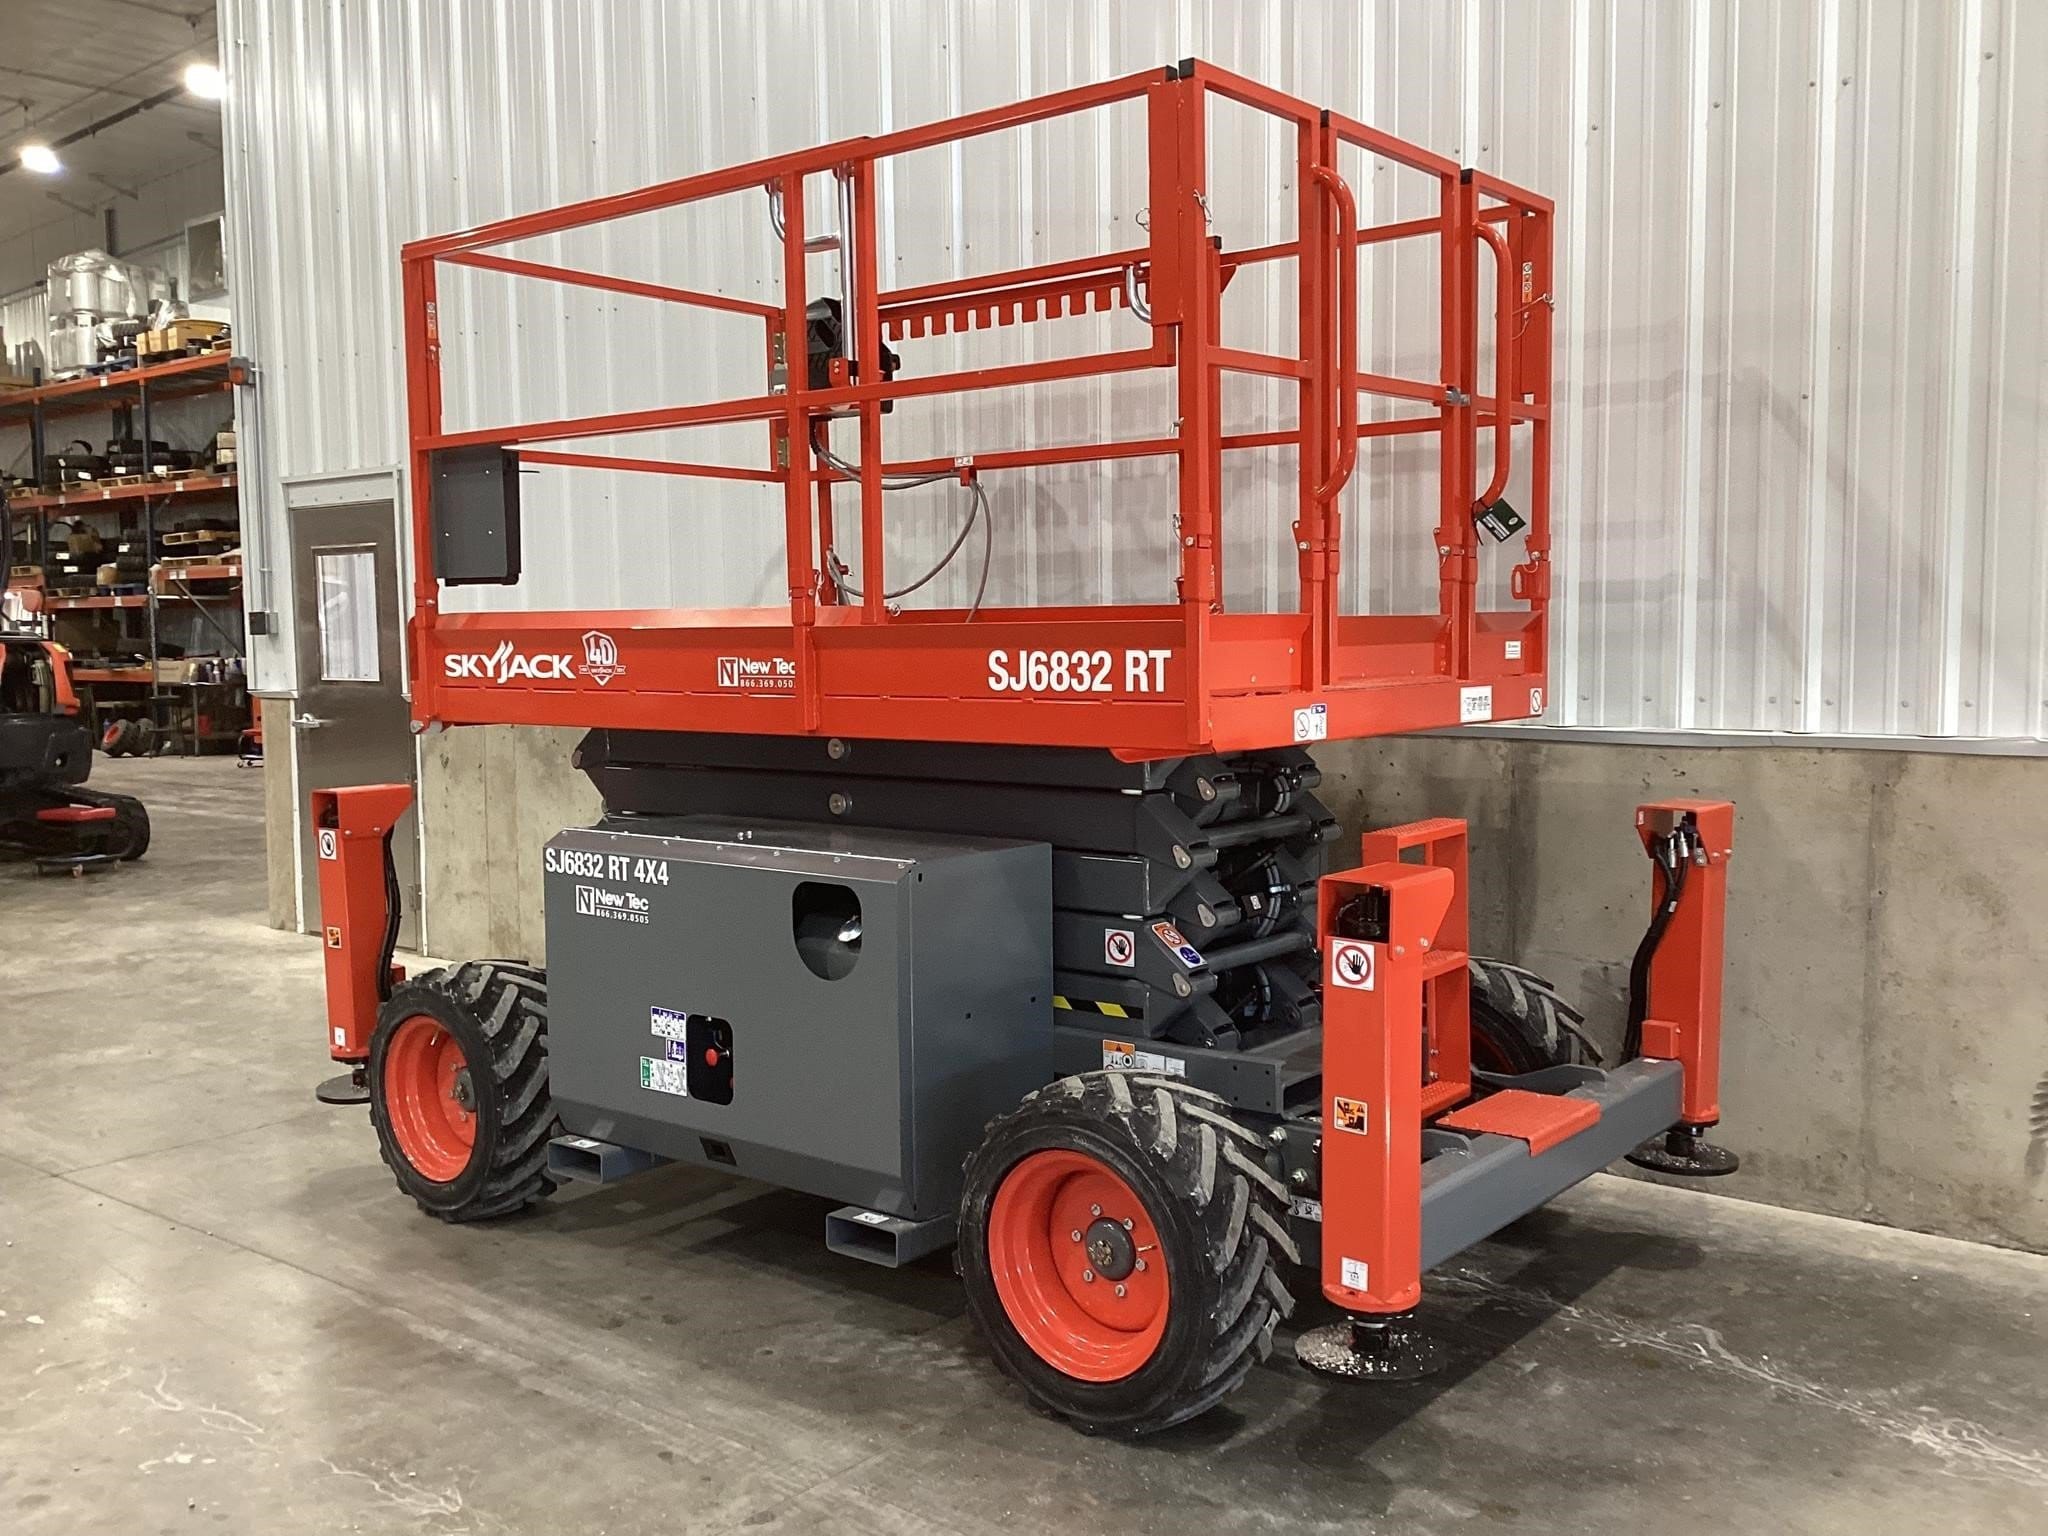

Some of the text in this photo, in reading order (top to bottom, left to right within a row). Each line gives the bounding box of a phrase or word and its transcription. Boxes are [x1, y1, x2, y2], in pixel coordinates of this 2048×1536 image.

[444, 640, 577, 684] SKYJACK
[589, 636, 613, 665] 40
[739, 657, 771, 674] New
[772, 657, 796, 675] Tec
[987, 649, 1172, 692] SJ6832 RT
[740, 678, 797, 688] 866.369.050
[545, 847, 669, 886] SJ6832 RT 4X4
[595, 888, 625, 907] New
[626, 892, 649, 911] Tec
[596, 908, 649, 924] 866.369.0505
